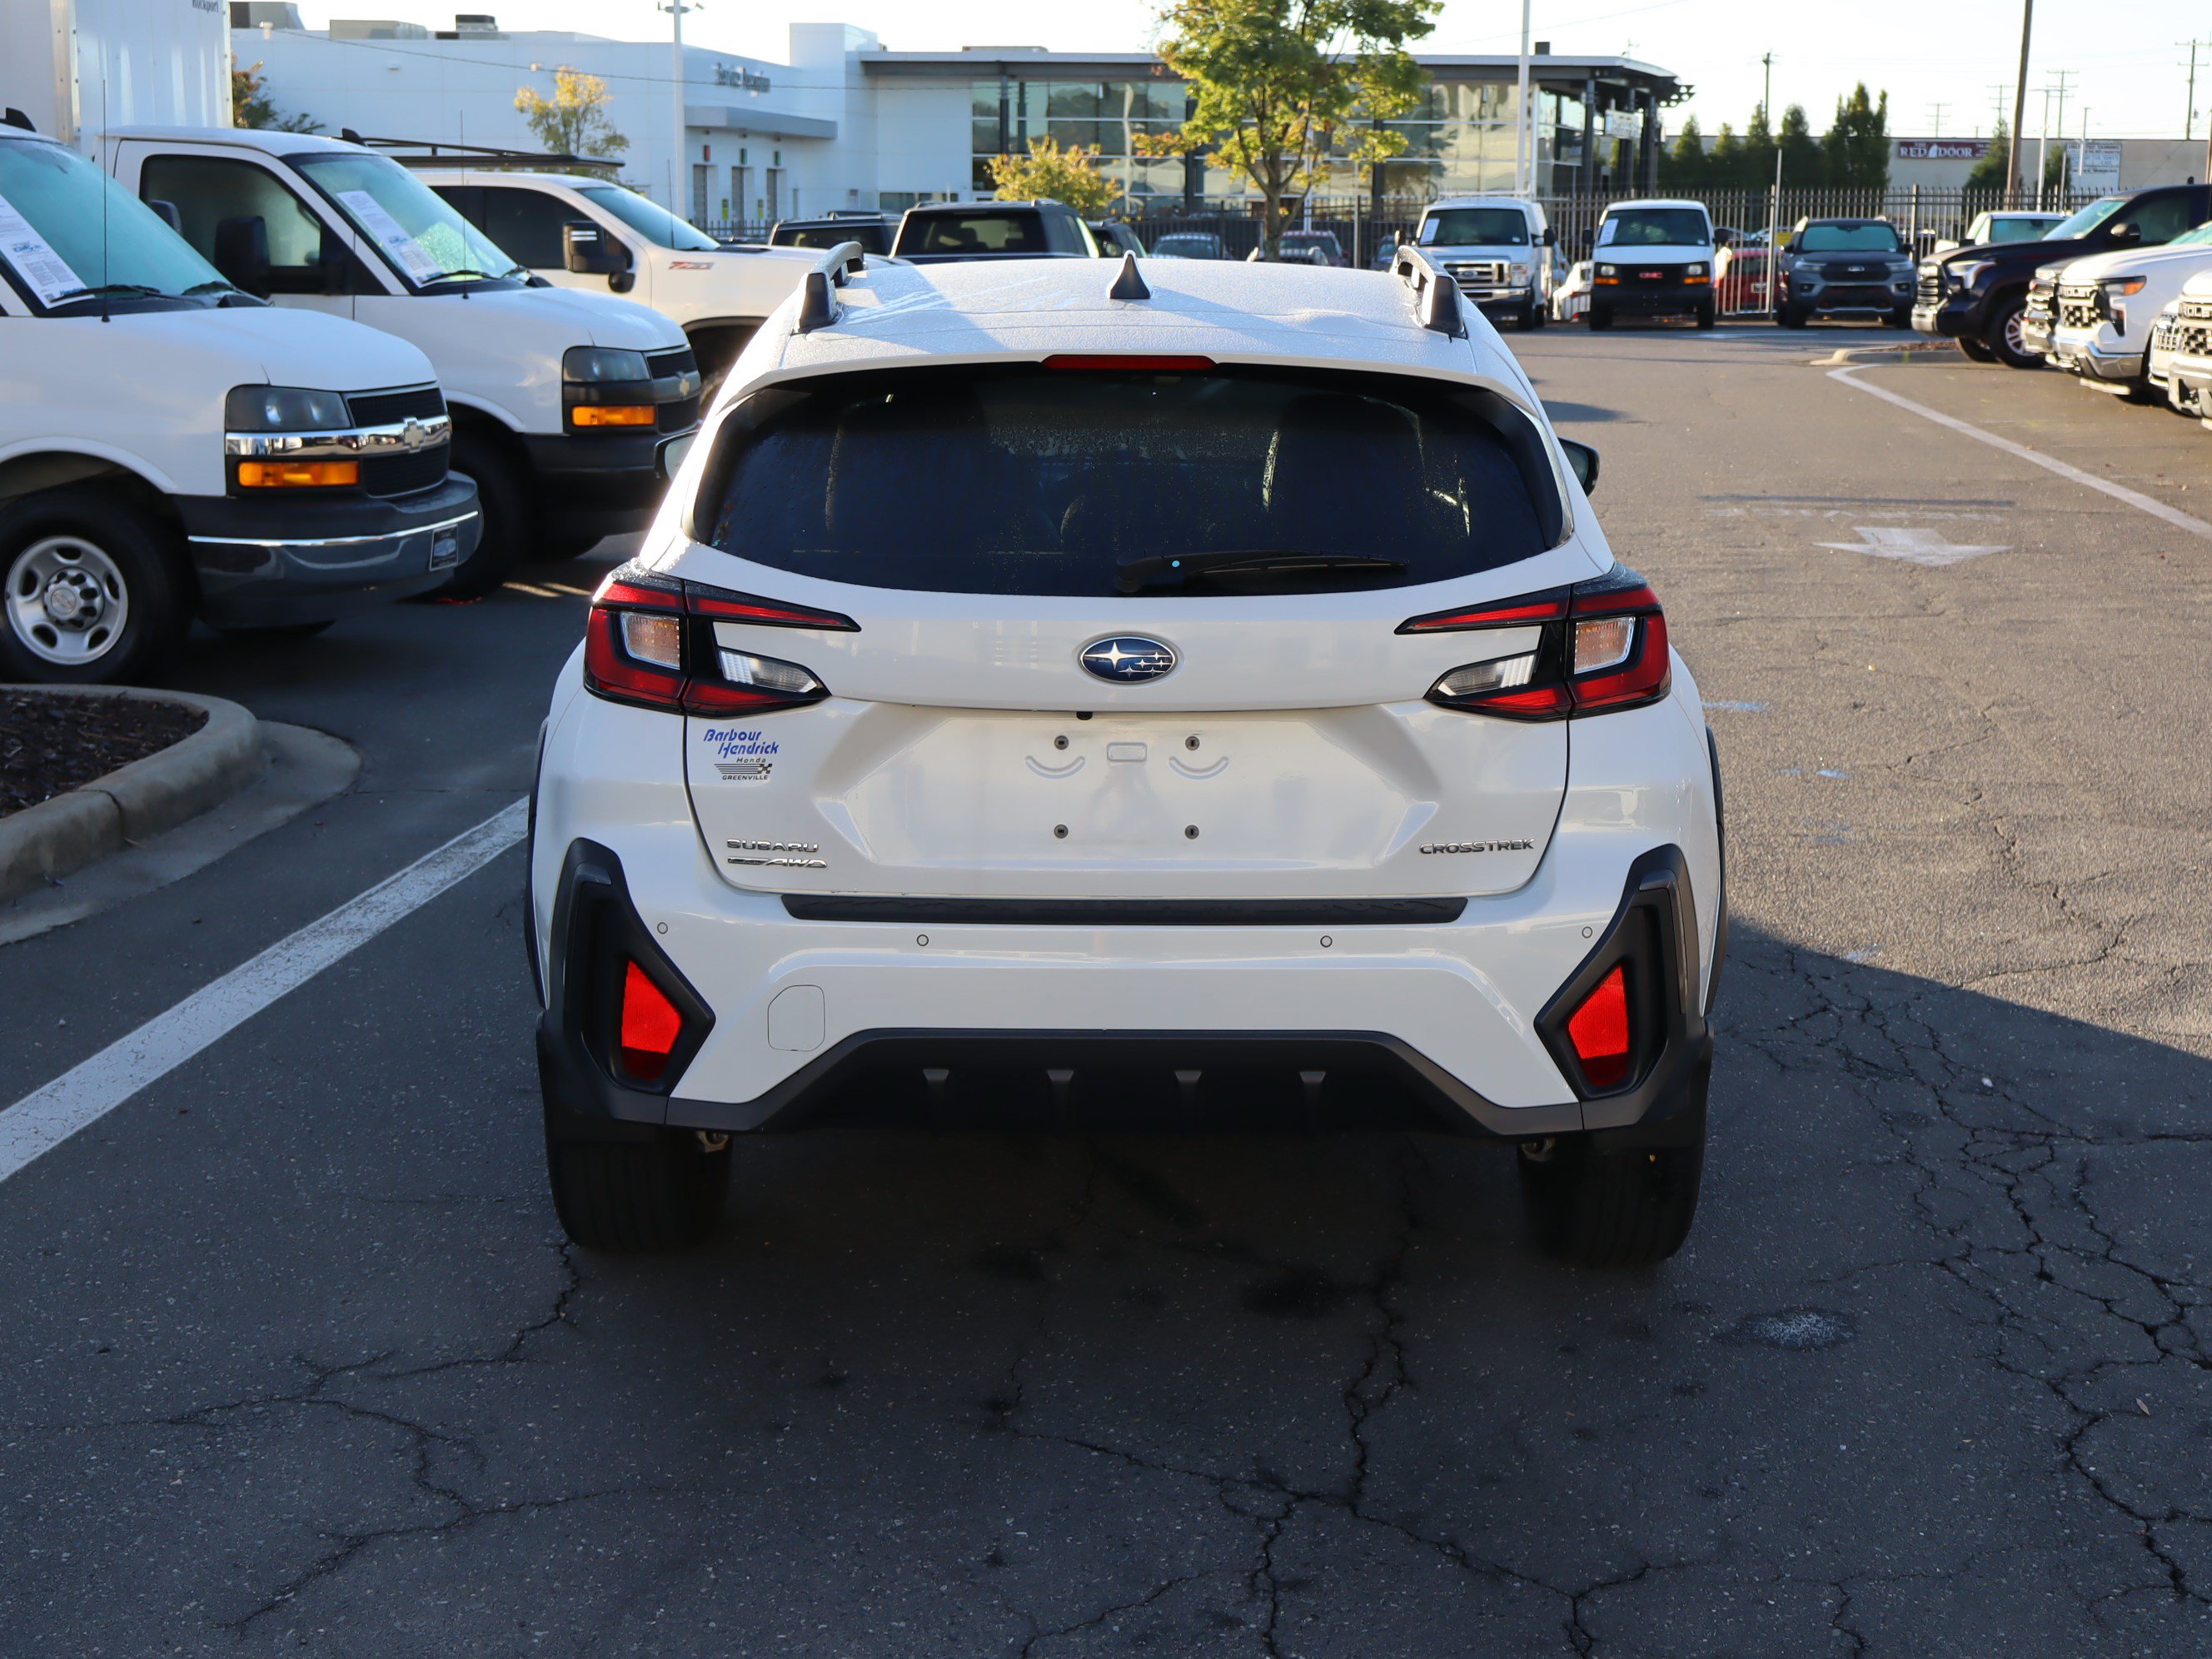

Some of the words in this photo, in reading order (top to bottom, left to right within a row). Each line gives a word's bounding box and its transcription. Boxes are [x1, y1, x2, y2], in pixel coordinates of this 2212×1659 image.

[1900, 147, 1927, 157] RED
[1938, 145, 1972, 157] DOOR
[703, 729, 761, 741] Barbour
[718, 741, 779, 759] Hendrick
[726, 839, 819, 853] SUBARU
[1419, 839, 1535, 854] CROSSTREK
